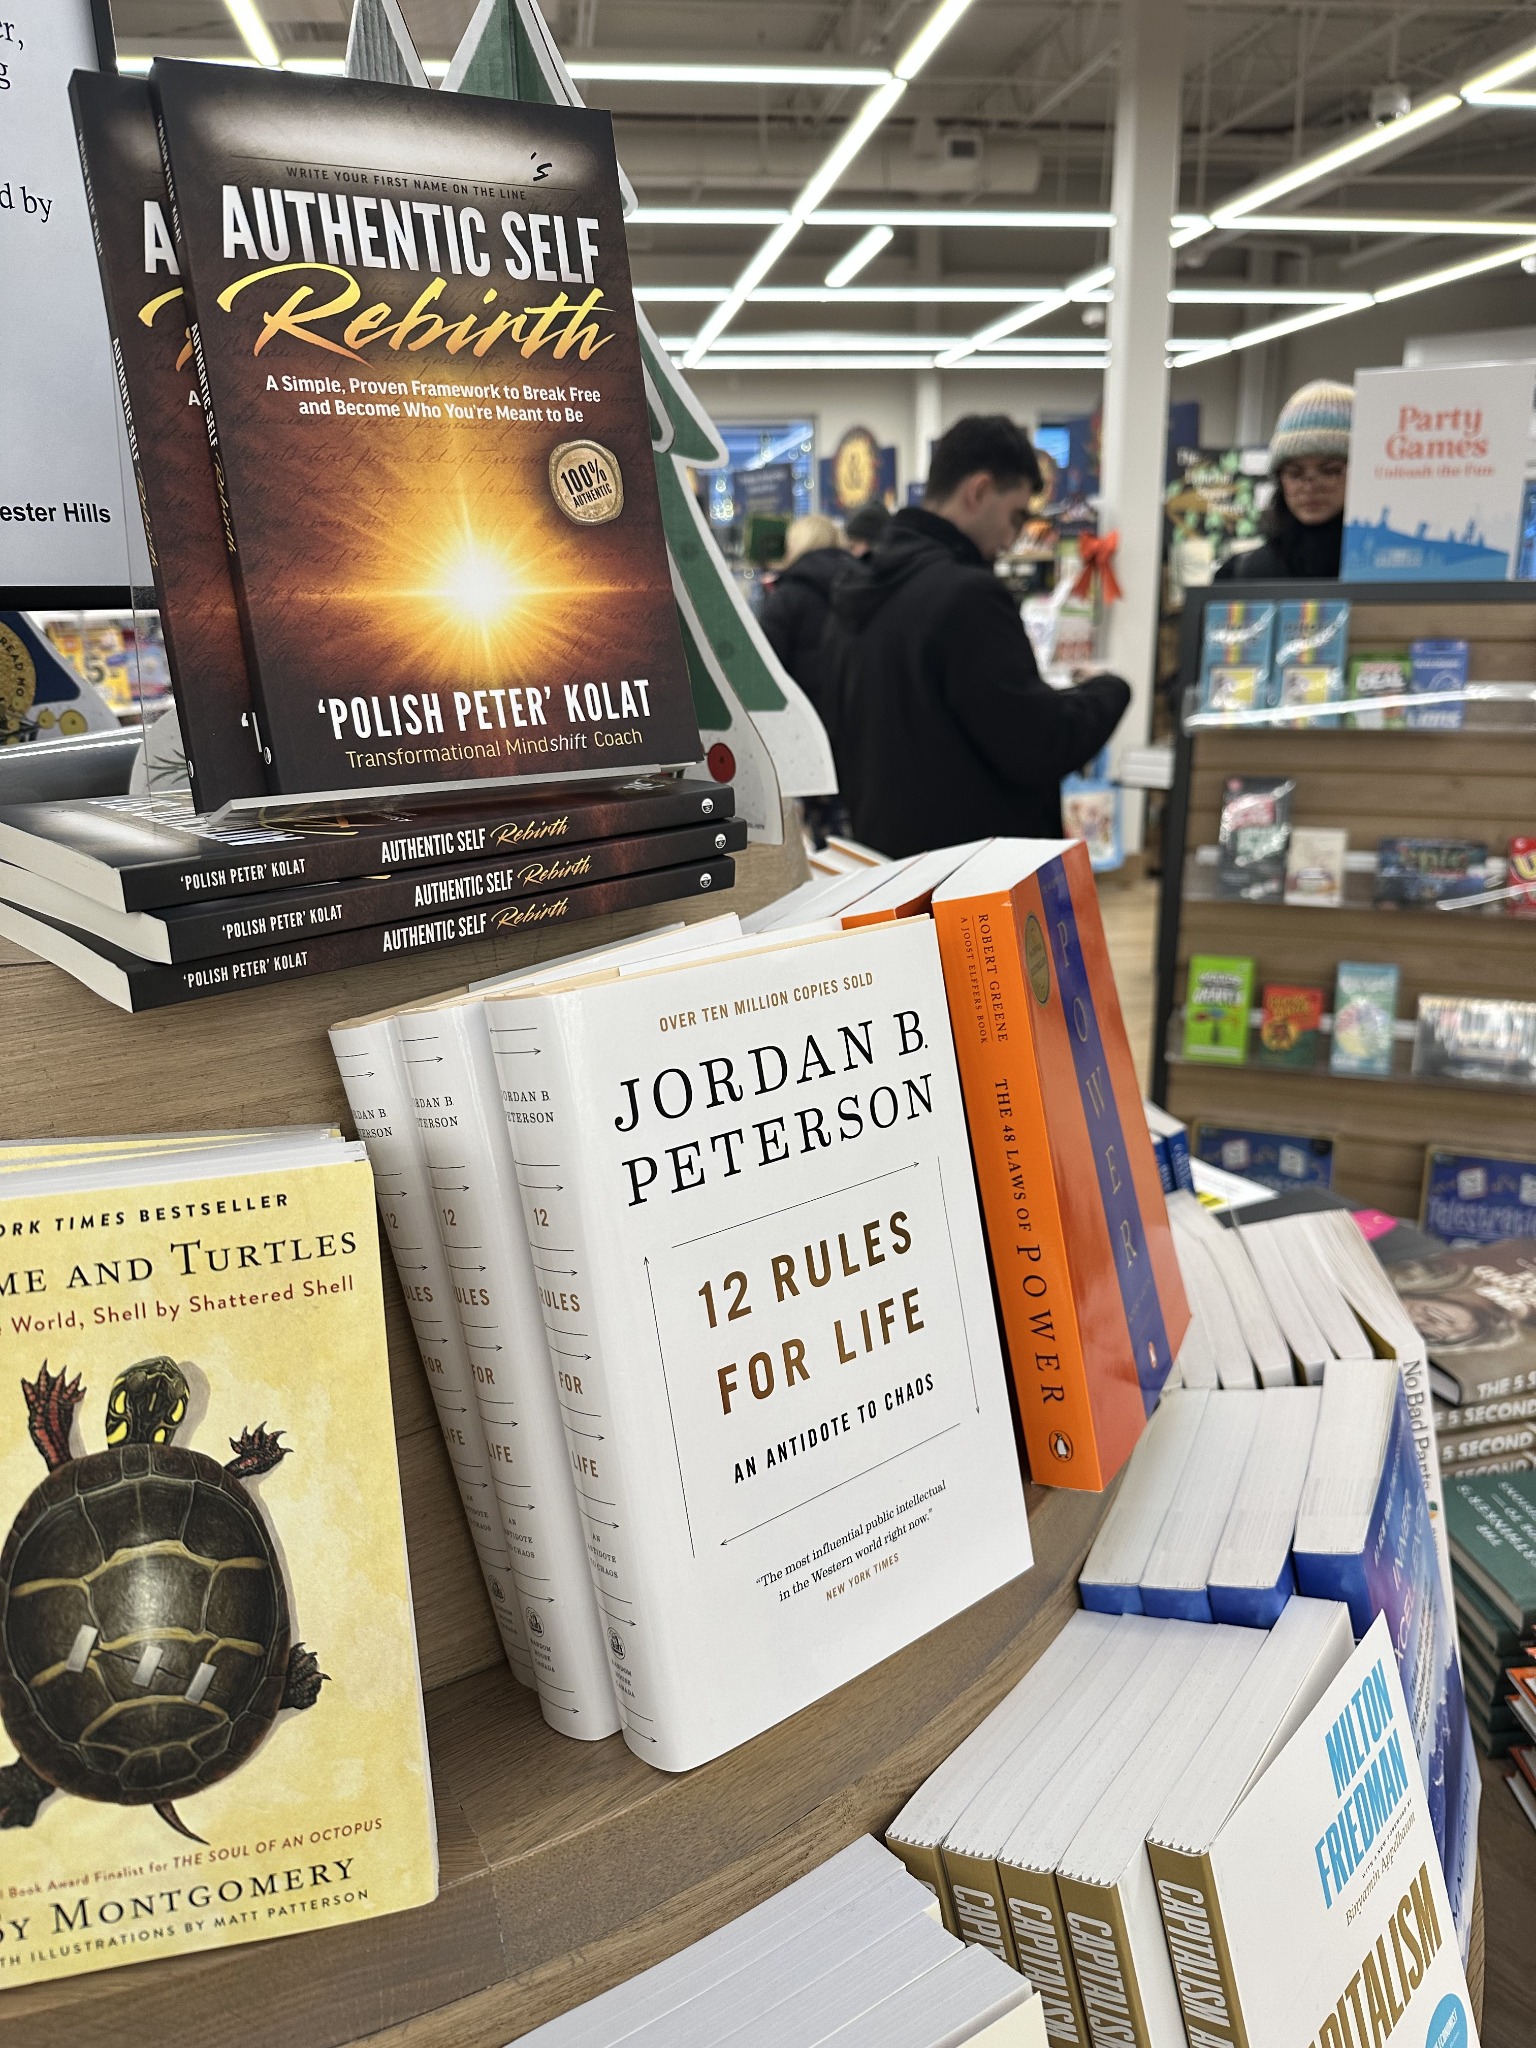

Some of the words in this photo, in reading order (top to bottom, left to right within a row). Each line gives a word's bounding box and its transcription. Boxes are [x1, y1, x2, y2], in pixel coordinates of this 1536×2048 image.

[19, 185, 53, 224] by
[286, 166, 328, 181] WRITE
[334, 170, 369, 184] YOUR
[373, 174, 410, 188] FIRST
[414, 179, 449, 193] NAME
[453, 182, 469, 195] ON
[473, 185, 497, 198] THE
[499, 187, 526, 200] LINE
[222, 184, 491, 278] AUTHENTIC
[501, 210, 600, 285] SELF
[216, 262, 617, 370] Rebirth
[112, 337, 133, 425] AUTHENTIC
[127, 424, 141, 462] SELF
[190, 322, 212, 411] AUTHENTIC
[205, 409, 219, 448] SELF
[265, 375, 280, 391] A
[281, 375, 346, 395] Simple,
[349, 378, 408, 396] Proven
[411, 380, 501, 400] Framework
[503, 386, 520, 400] to
[523, 385, 566, 402] Break
[569, 387, 602, 403] Free
[299, 400, 334, 417] and
[336, 400, 401, 418] Become
[403, 402, 442, 419] Who
[444, 403, 493, 421] You're
[496, 406, 543, 423] Meant
[545, 408, 562, 423] to
[565, 407, 584, 424] Be
[1397, 402, 1485, 438] Party
[1384, 432, 1490, 461] Games
[561, 458, 607, 495] 100%
[572, 483, 613, 508] AUTHENTIC
[0, 502, 57, 522] ester
[63, 502, 112, 523] Hills
[563, 679, 651, 723] KOLAT
[345, 739, 501, 770] Transformational
[505, 733, 588, 756] Mindshift
[594, 728, 643, 749] Coach
[381, 832, 455, 864] AUTHENTIC
[457, 828, 486, 853] SELF
[489, 815, 570, 846] Rebirth
[271, 858, 306, 878] KOLAT
[414, 874, 484, 907] AUTHENTIC
[486, 869, 514, 894] SELF
[517, 854, 593, 888] Rebirth
[310, 904, 343, 925] KOLAT
[382, 918, 456, 952] AUTHENTIC
[458, 912, 487, 937] SELF
[490, 897, 570, 930] Rebirth
[960, 916, 968, 924] A
[273, 951, 308, 972] KOLAT
[960, 927, 975, 960] JOOST
[968, 964, 983, 1012] ELFFERS
[978, 913, 998, 974] ROBERT
[989, 980, 1009, 1043] GREENE
[659, 1010, 697, 1032] OVER
[701, 1003, 729, 1023] TEN
[733, 990, 789, 1015] MILLION
[793, 979, 839, 1002] COPIES
[843, 972, 874, 991] SOLD
[976, 1014, 989, 1044] BOOK
[614, 1020, 874, 1133] JORDAN
[892, 1009, 929, 1057] B.
[994, 1078, 1014, 1119] THE
[621, 1073, 934, 1207] PETERSON
[1003, 1124, 1017, 1143] 48
[1005, 1148, 1029, 1202] LAWS
[55, 1211, 126, 1232] TIMES
[139, 1193, 289, 1223] BESTSELLER
[533, 1207, 550, 1228] 12
[1015, 1207, 1033, 1234] OF
[0, 1268, 48, 1297] ME
[66, 1257, 153, 1289] AND
[698, 1270, 753, 1329] 12
[770, 1210, 912, 1303] RULES
[11, 1311, 86, 1335] World,
[93, 1301, 148, 1324] Shell
[156, 1300, 181, 1322] by
[189, 1284, 295, 1313] Shattered
[303, 1274, 355, 1298] Shell
[1015, 1243, 1066, 1406] POWER
[717, 1337, 811, 1416] FOR
[833, 1286, 925, 1365] LIFE
[558, 1371, 584, 1395] FOR
[1402, 1359, 1422, 1390] No
[1477, 1376, 1513, 1399] THE
[734, 1456, 757, 1484] AN
[766, 1412, 851, 1469] ANTIDOTE
[857, 1399, 877, 1424] TO
[884, 1372, 935, 1411] CHAOS
[1406, 1392, 1428, 1432] Bad
[571, 1450, 599, 1479] LIFE
[1442, 1445, 1454, 1463] 5
[1459, 1431, 1534, 1458] SECOND
[784, 1555, 812, 1576] most
[812, 1523, 865, 1562] influential
[865, 1508, 895, 1535] public
[895, 1479, 947, 1516] intellectual
[779, 1589, 791, 1603] in
[792, 1577, 810, 1595] the
[811, 1555, 854, 1584] Western
[855, 1536, 883, 1560] world
[883, 1523, 908, 1546] right
[825, 1582, 846, 1602] NEW
[848, 1568, 872, 1589] YORK
[873, 1552, 900, 1575] TIMES
[1325, 1658, 1394, 1800] MILTON
[1314, 1728, 1410, 1910] FRIEDMAN
[8, 1882, 43, 1898] Book
[47, 1874, 91, 1892] Award
[94, 1864, 145, 1884] Finalist
[148, 1860, 170, 1874] for
[173, 1852, 204, 1870] THE
[208, 1844, 250, 1864] SOUL
[255, 1839, 278, 1856] OF
[282, 1834, 305, 1850] AN
[309, 1817, 384, 1845] OCTOPUS
[49, 1857, 356, 1936] MONTGOMERY
[30, 1925, 176, 1964] ILLUSTRATIONS
[184, 1918, 206, 1934] BY
[213, 1911, 259, 1930] MATT
[267, 1888, 370, 1919] PATTERSON
[1158, 1879, 1231, 2028] CAPITALISM
